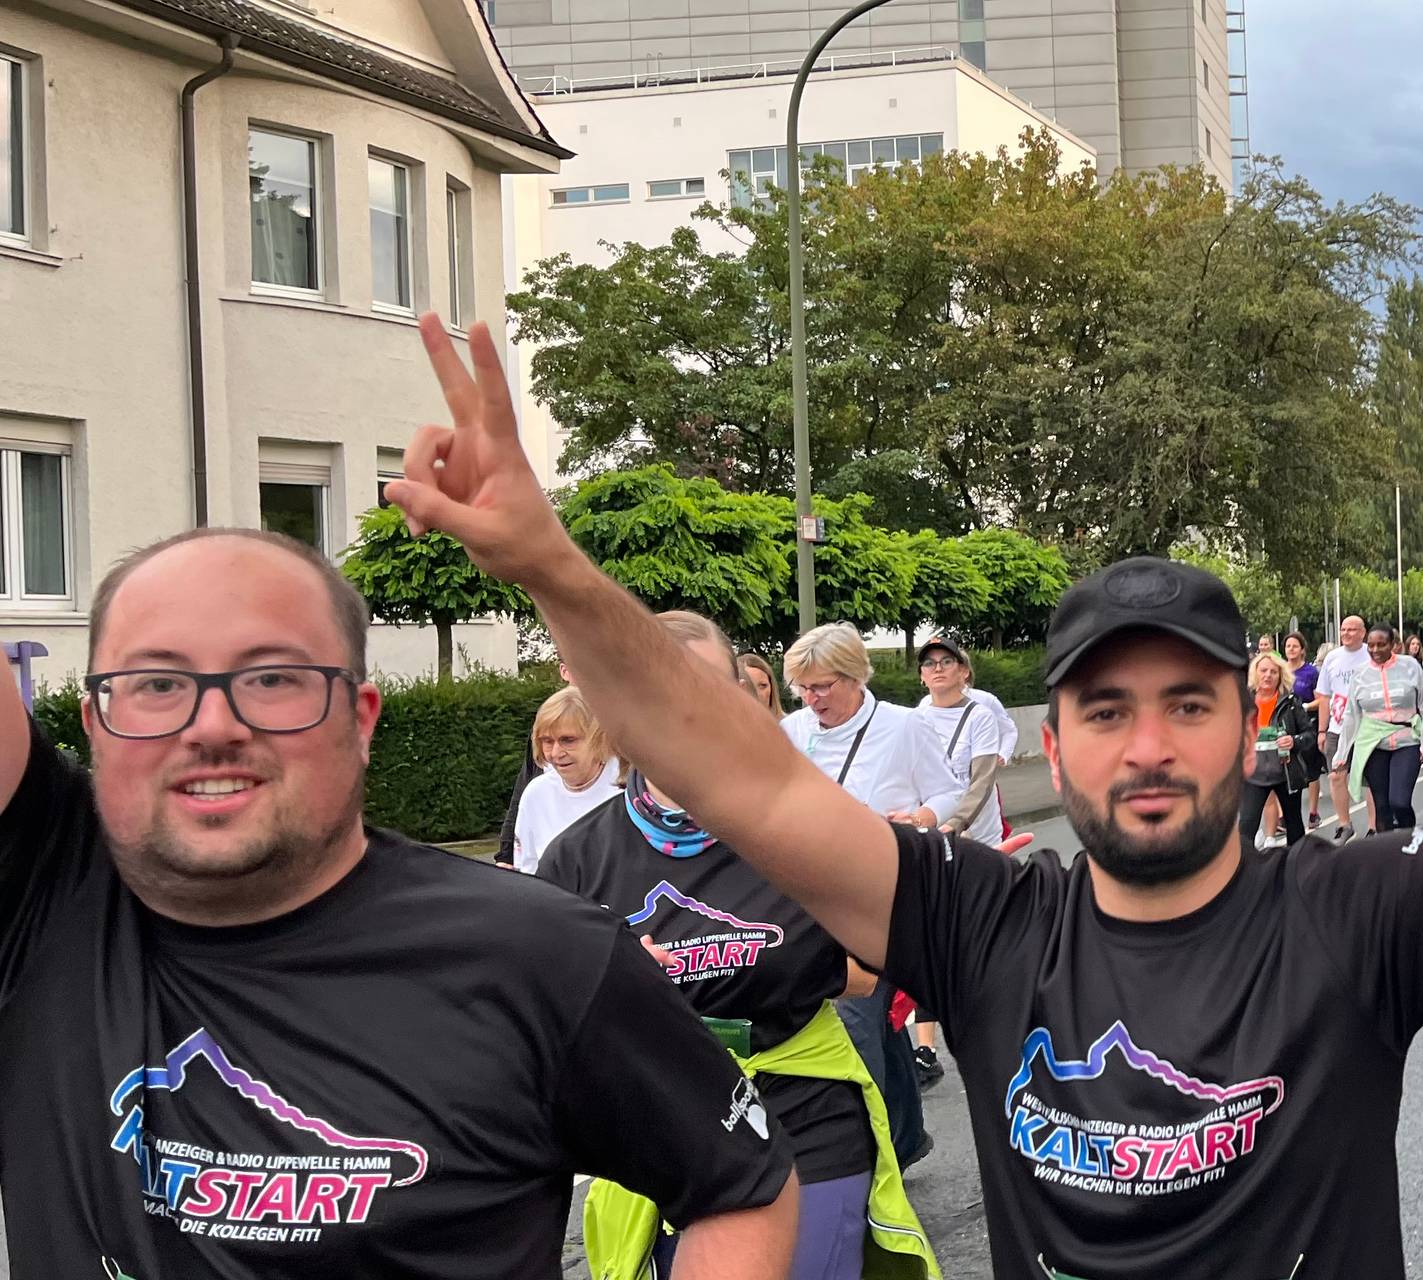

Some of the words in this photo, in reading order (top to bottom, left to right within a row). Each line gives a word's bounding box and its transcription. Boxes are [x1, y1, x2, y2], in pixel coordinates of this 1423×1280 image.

[681, 937, 701, 947] RADIO
[702, 932, 741, 943] LIPPEWELLE
[742, 932, 766, 940] HAMM
[666, 940, 766, 976] START
[1128, 1125, 1136, 1136] &
[1139, 1124, 1173, 1138] RADIO
[1227, 1094, 1262, 1118] HAMM
[155, 1138, 214, 1164] ANZEIGER
[216, 1151, 226, 1166] &
[265, 1155, 341, 1170] LIPPEWELLE
[343, 1156, 391, 1170] HAMM
[1010, 1105, 1264, 1181] KALTSTART
[1033, 1163, 1059, 1182] WIR
[1060, 1172, 1114, 1195] MACHEN
[1115, 1181, 1132, 1195] DIE
[1134, 1174, 1200, 1196] KOLLEGEN
[1203, 1166, 1226, 1184] FIT!
[180, 1218, 208, 1235] DIE
[208, 1222, 288, 1242] KOLLEGEN
[291, 1228, 321, 1242] FIT!
